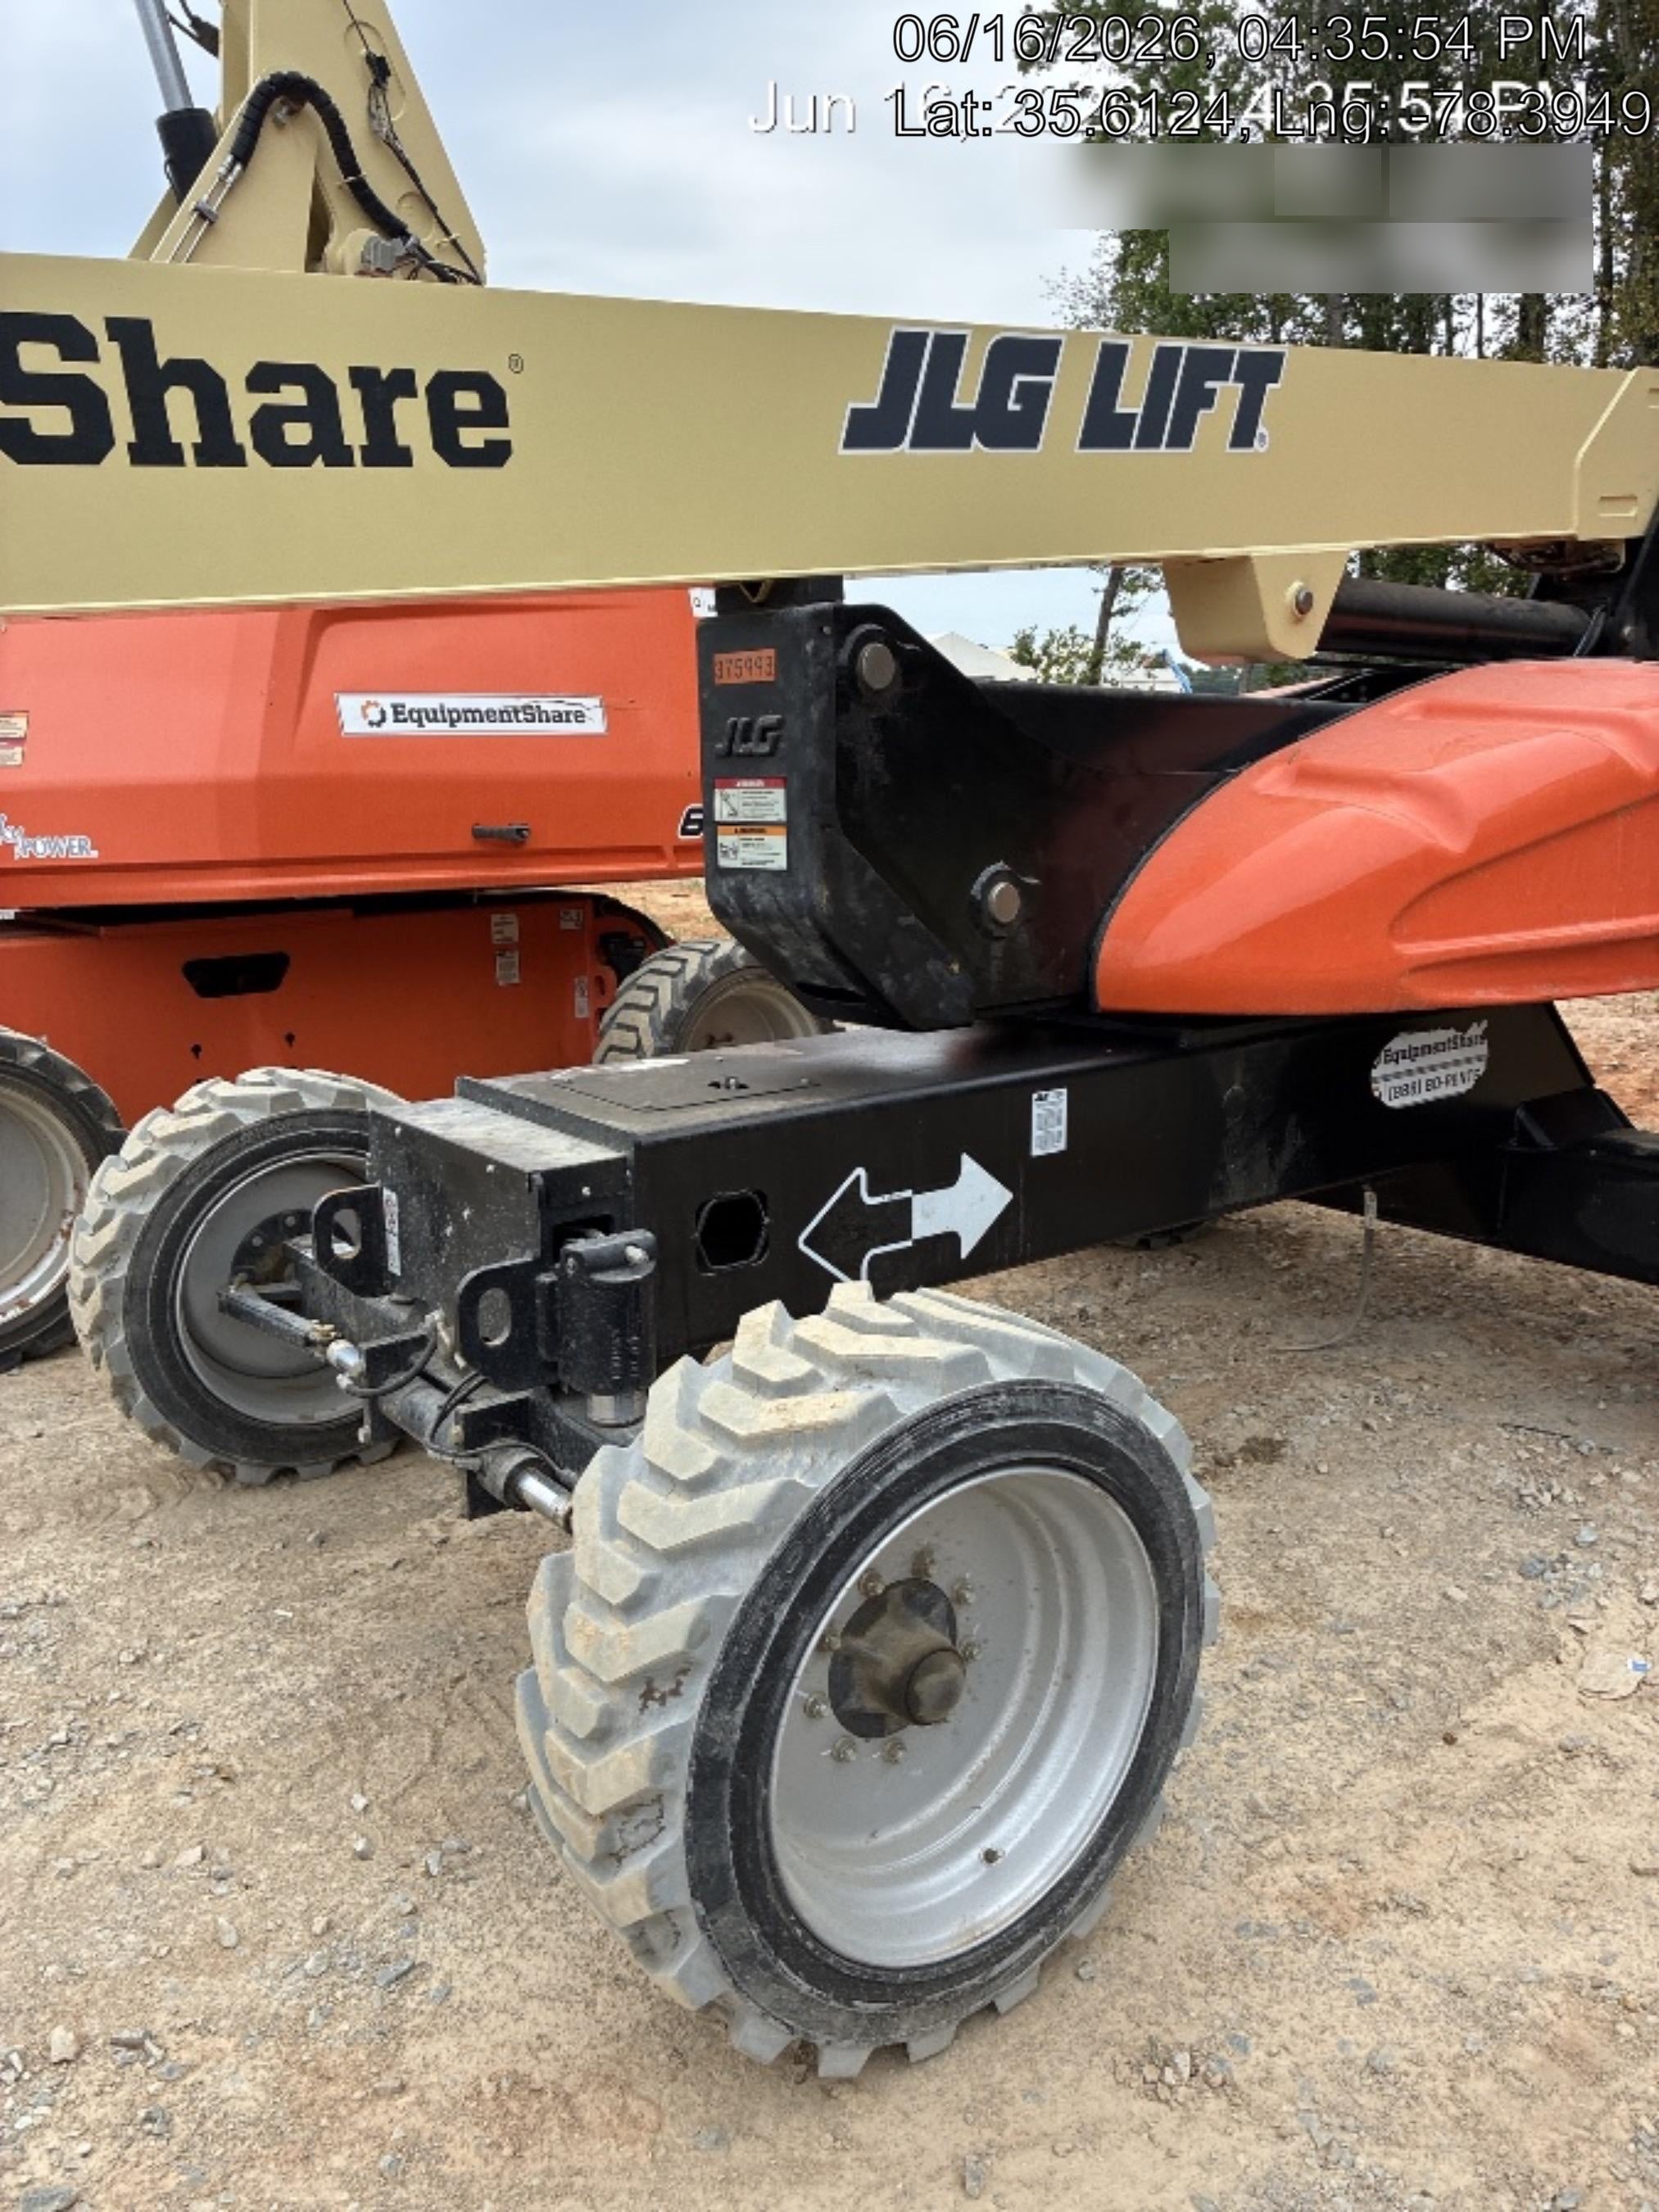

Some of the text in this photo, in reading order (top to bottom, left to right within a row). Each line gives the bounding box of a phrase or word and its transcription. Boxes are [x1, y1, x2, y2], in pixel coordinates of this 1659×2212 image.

[838, 326, 1288, 453] JLG LIFT
[391, 702, 587, 728] EquipmentShare
[714, 714, 784, 758] JLG
